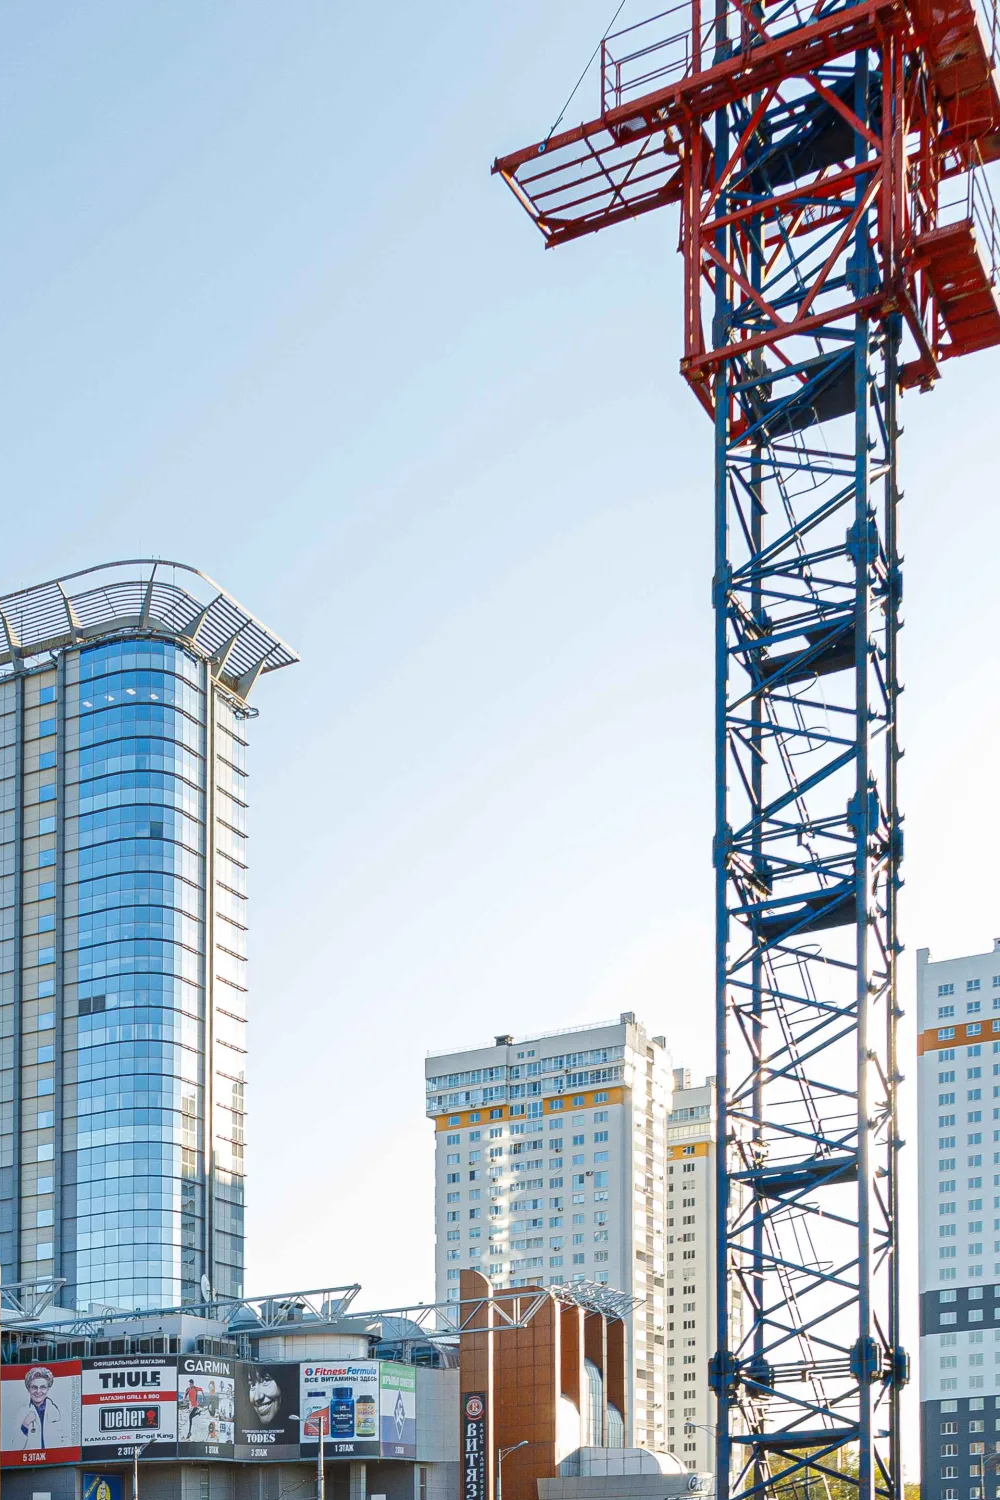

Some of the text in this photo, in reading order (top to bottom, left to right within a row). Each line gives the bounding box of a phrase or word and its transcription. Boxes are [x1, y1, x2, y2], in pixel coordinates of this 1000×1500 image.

[93, 1359, 139, 1367] ОФИЦИАЛЬНЫЙ
[184, 1359, 231, 1375] GARMIN
[99, 1371, 160, 1389] THULE
[104, 1407, 145, 1428] weber
[246, 1433, 276, 1443] TODES
[117, 1448, 122, 1456] 2
[339, 1444, 355, 1452] ЭТАЖ
[22, 1452, 46, 1461] 5 ЭТАЖ
